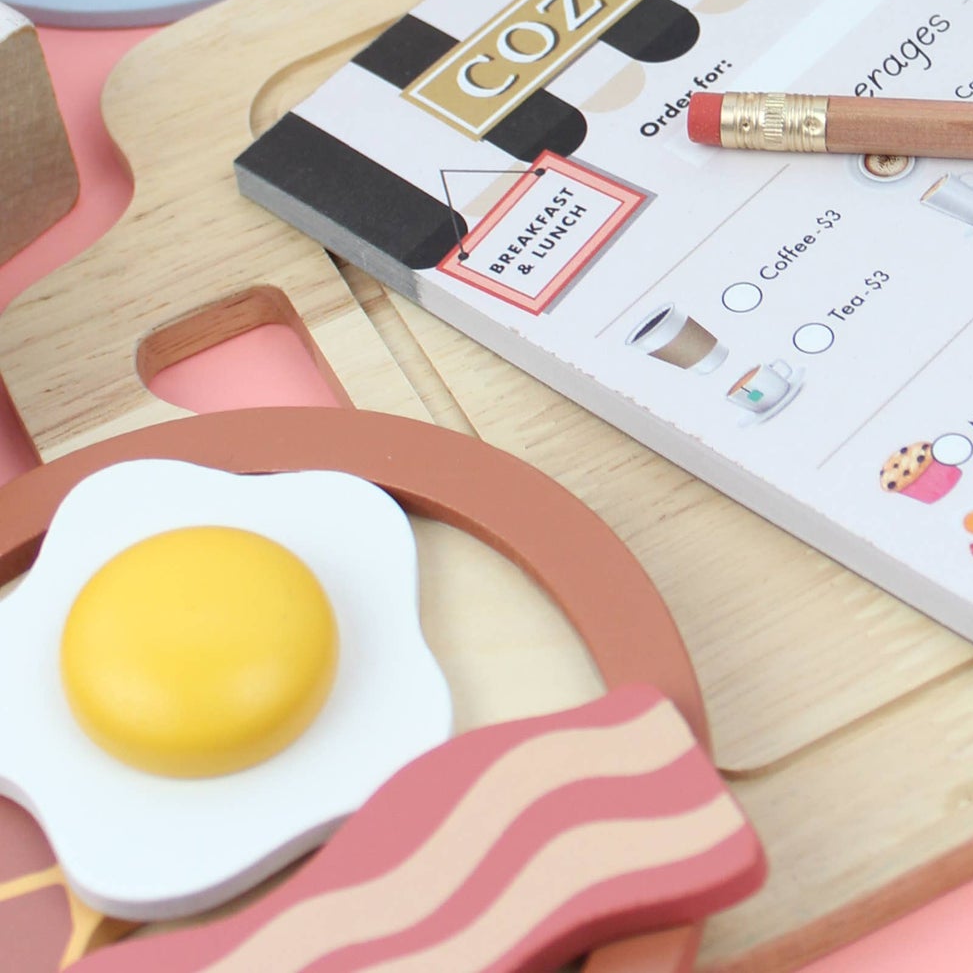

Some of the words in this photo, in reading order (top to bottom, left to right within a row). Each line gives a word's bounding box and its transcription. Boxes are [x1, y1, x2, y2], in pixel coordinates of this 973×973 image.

[693, 59, 733, 89] for:
[854, 13, 951, 98] erages
[488, 186, 575, 275] BREAKFAST
[517, 262, 536, 276] &
[531, 204, 588, 260] LUNCH
